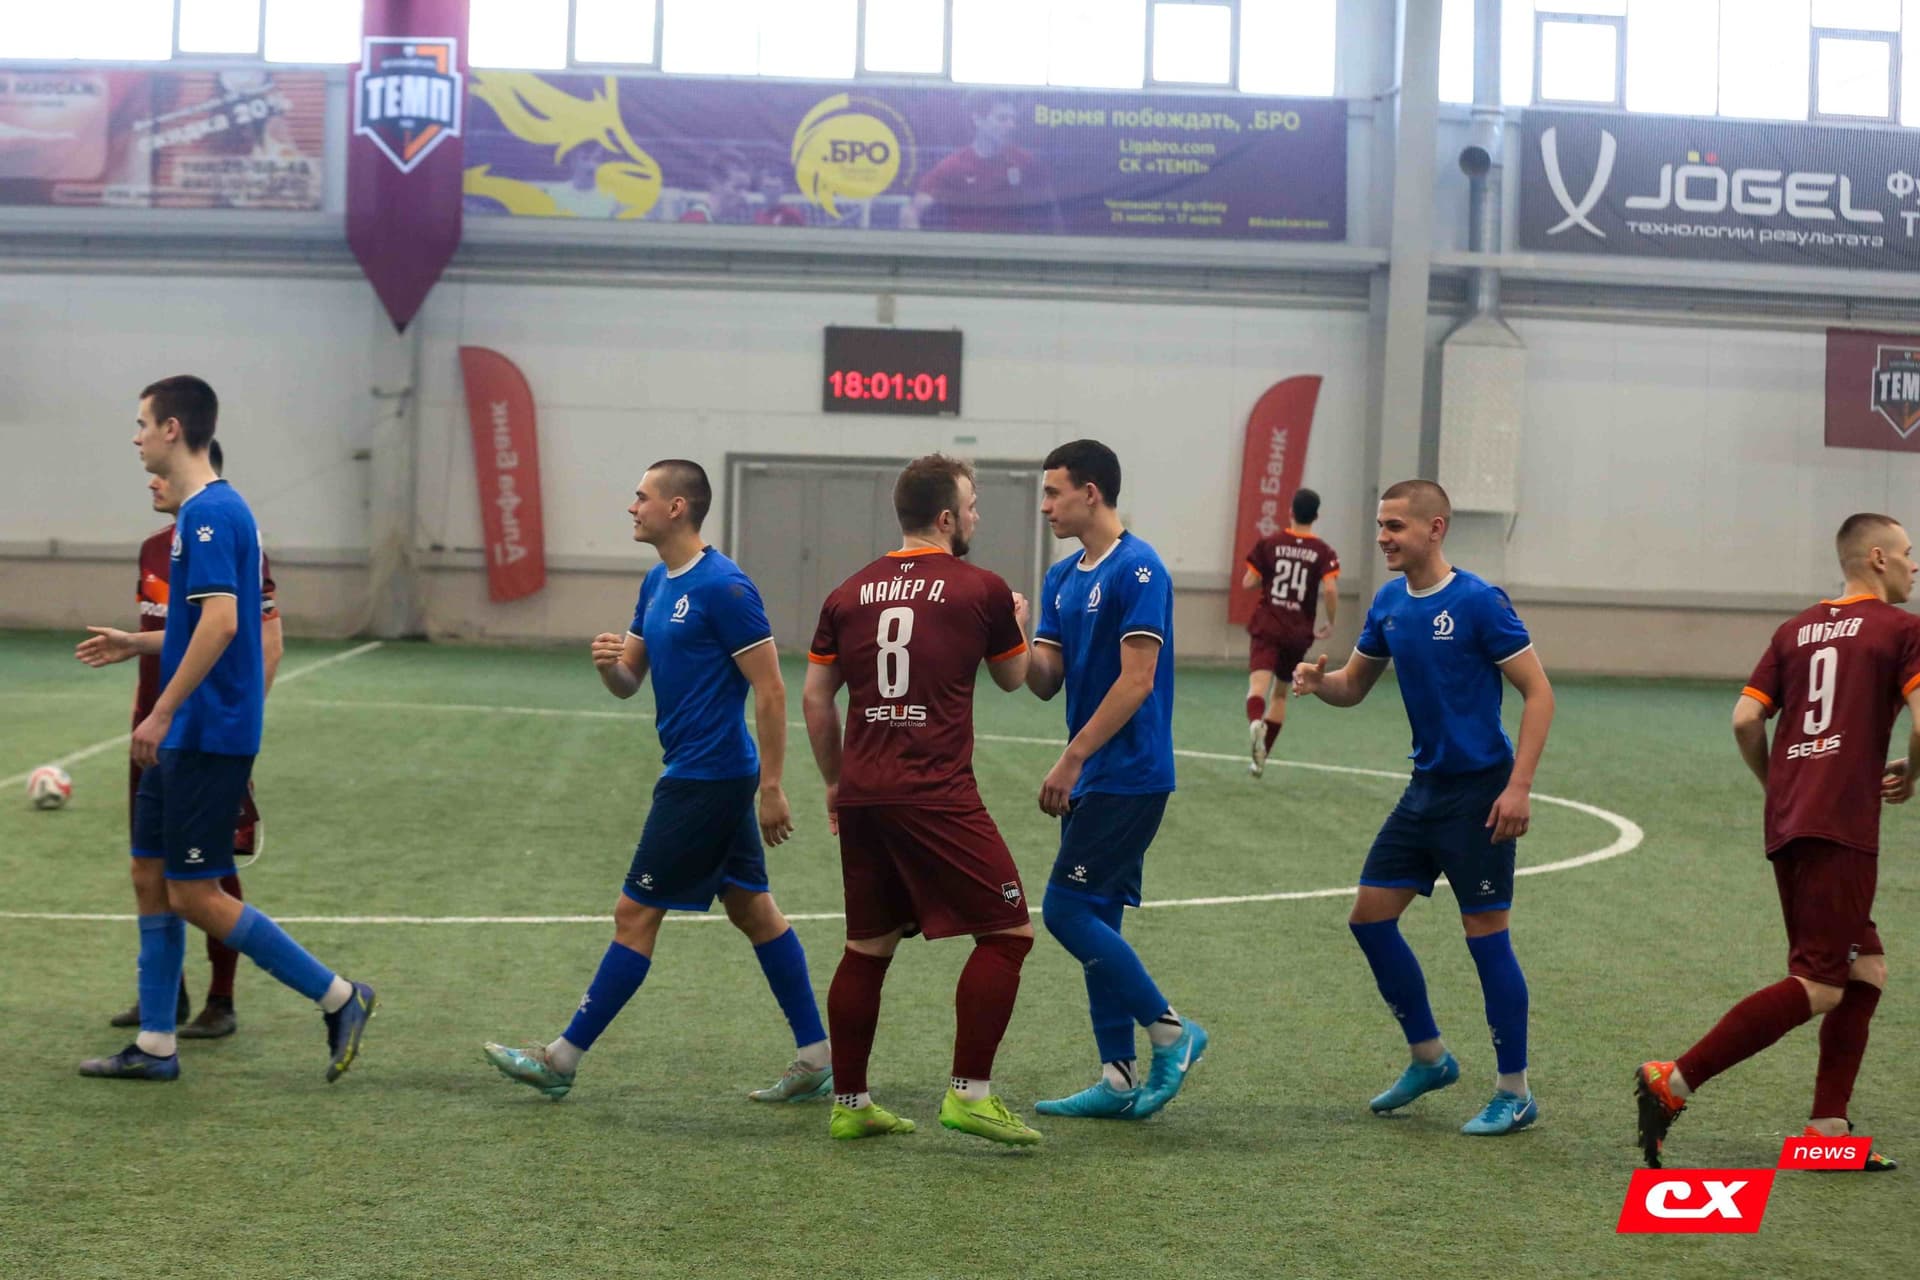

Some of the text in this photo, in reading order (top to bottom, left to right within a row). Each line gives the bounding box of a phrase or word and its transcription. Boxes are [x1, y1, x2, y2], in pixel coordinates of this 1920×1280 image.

[365, 75, 451, 123] ТЕМП
[1034, 104, 1301, 133] Время побеждать, .БРО
[821, 139, 890, 165] .БРО
[1119, 139, 1216, 157] Ligabro.com
[1119, 158, 1142, 173] СК
[1624, 150, 1884, 223] JÖGEL
[1625, 220, 1885, 248] технологии результата
[828, 370, 948, 402] 18:01:01
[1261, 427, 1289, 495] Банк
[859, 576, 947, 606] МАЙЕР А.
[1270, 559, 1309, 602] 24
[1796, 617, 1865, 648] ШИБАЕВ
[876, 606, 915, 699] 8
[1802, 646, 1838, 736] 9
[864, 704, 928, 724] SEUS
[1786, 734, 1842, 760] SEUS
